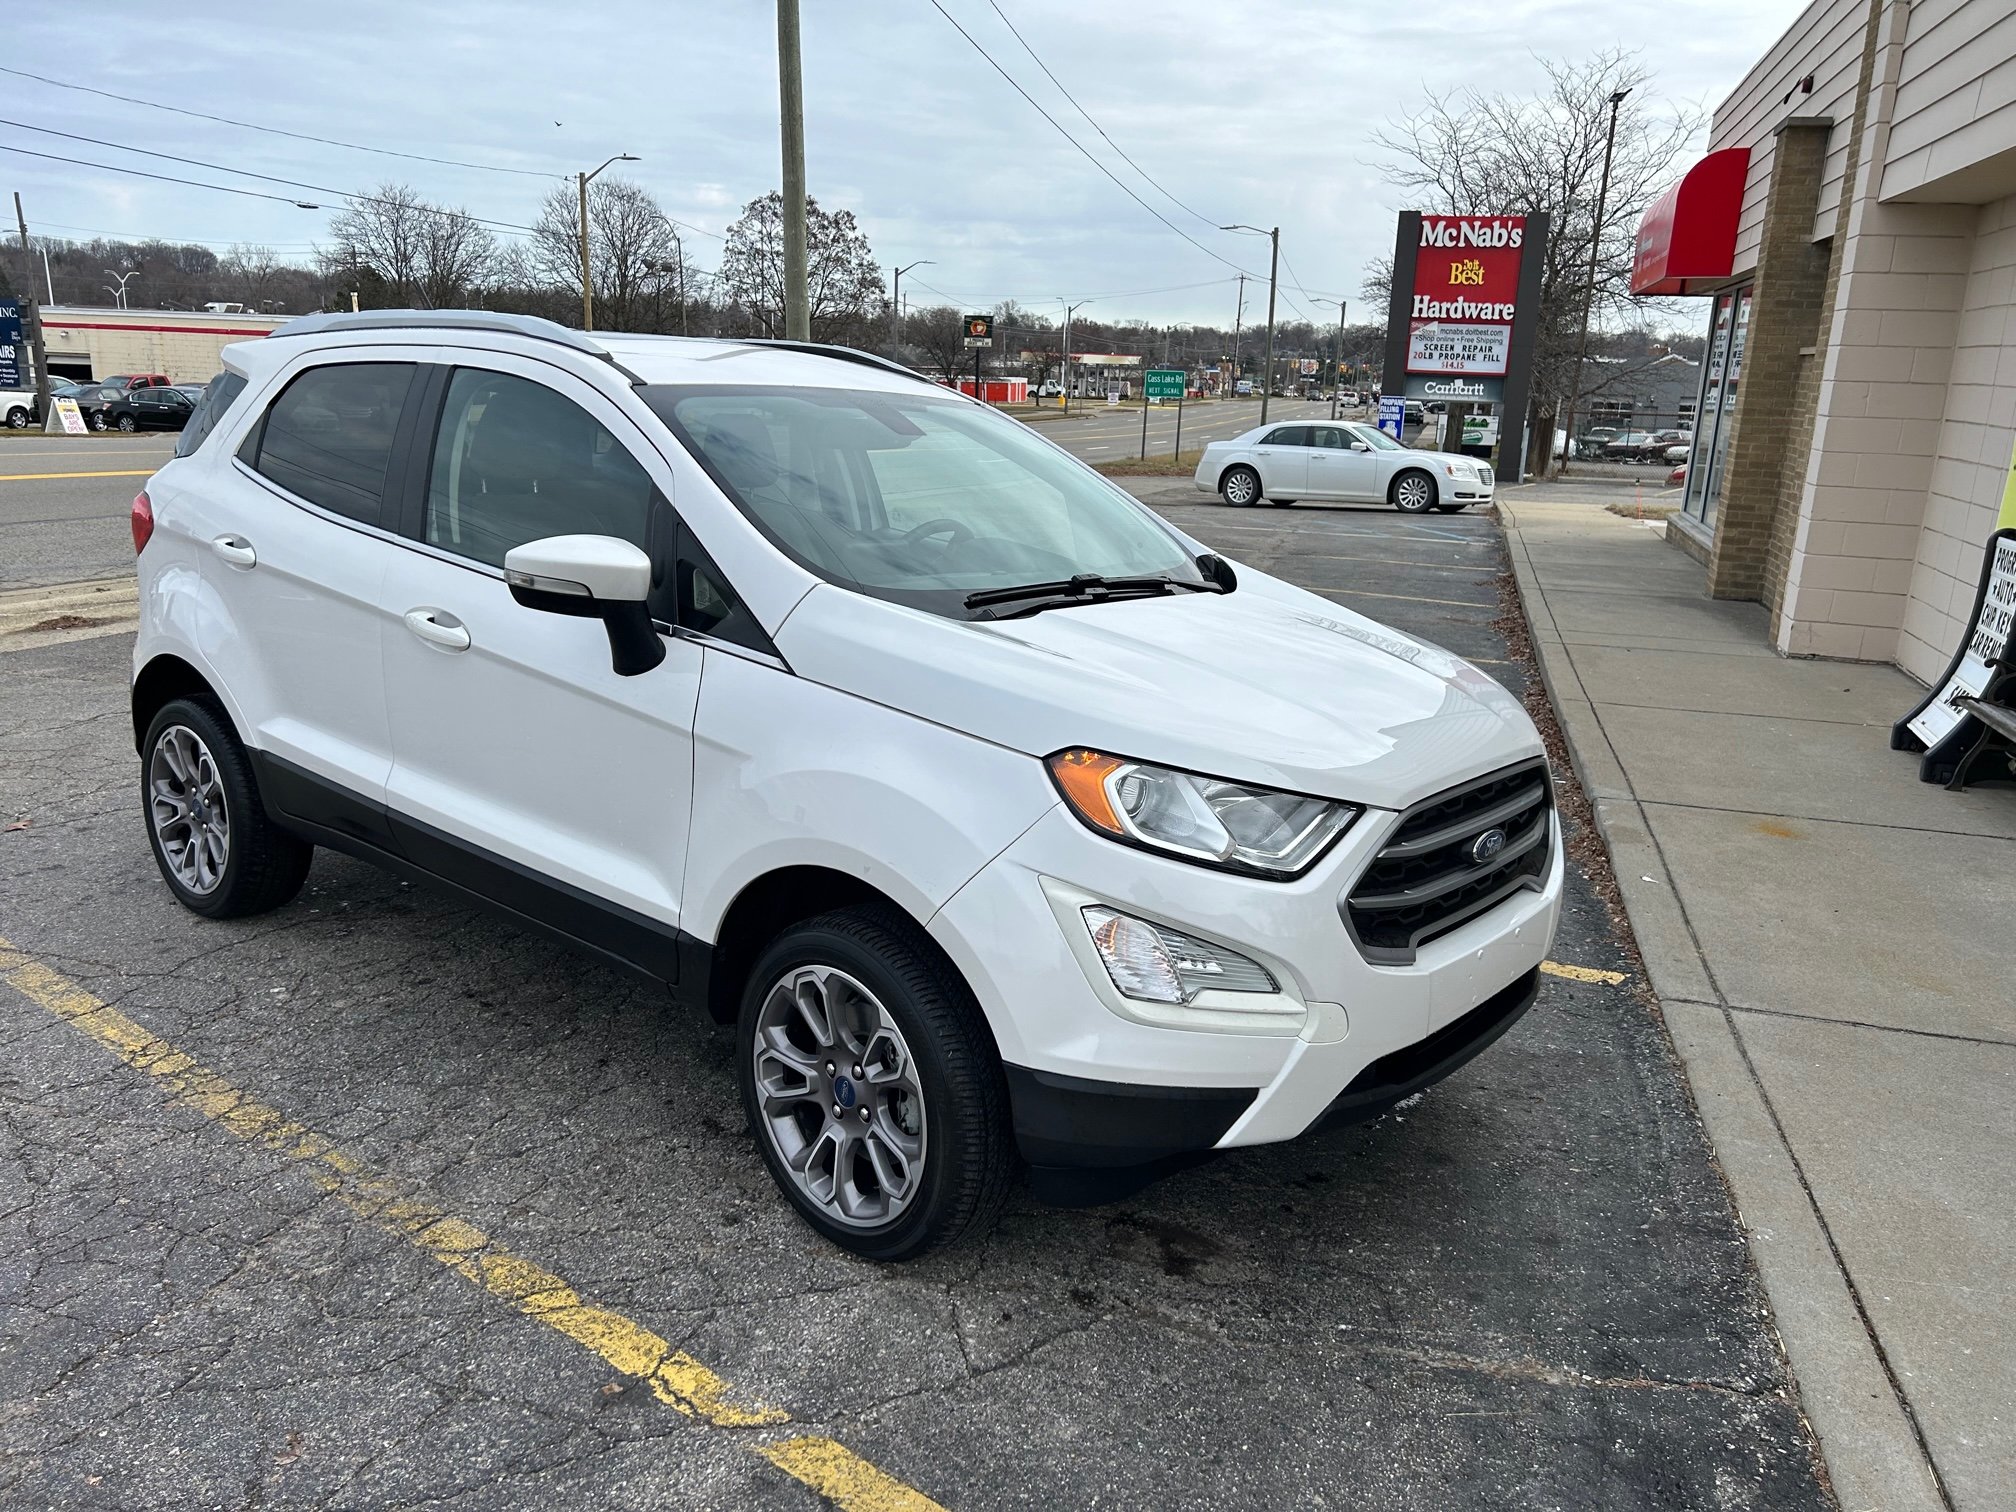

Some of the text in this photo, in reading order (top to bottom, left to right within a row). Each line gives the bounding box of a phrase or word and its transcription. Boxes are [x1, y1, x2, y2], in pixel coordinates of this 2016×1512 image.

[1420, 220, 1522, 248] McNab's
[1448, 262, 1485, 285] Best
[1411, 295, 1515, 320] Hardware
[1476, 337, 1503, 346] Shipping
[1424, 343, 1493, 353] SCREEN REPAIR
[1413, 351, 1501, 362] 20LB PROPANE FILL
[1148, 374, 1183, 383] Cass Lake Rd
[1163, 387, 1180, 395] SIGNAL
[1424, 381, 1484, 395] Carhartt
[1380, 398, 1404, 406] PROPANE
[1380, 405, 1399, 413] FILLING
[1379, 412, 1400, 420] STATION
[1996, 609, 2011, 637] KEY
